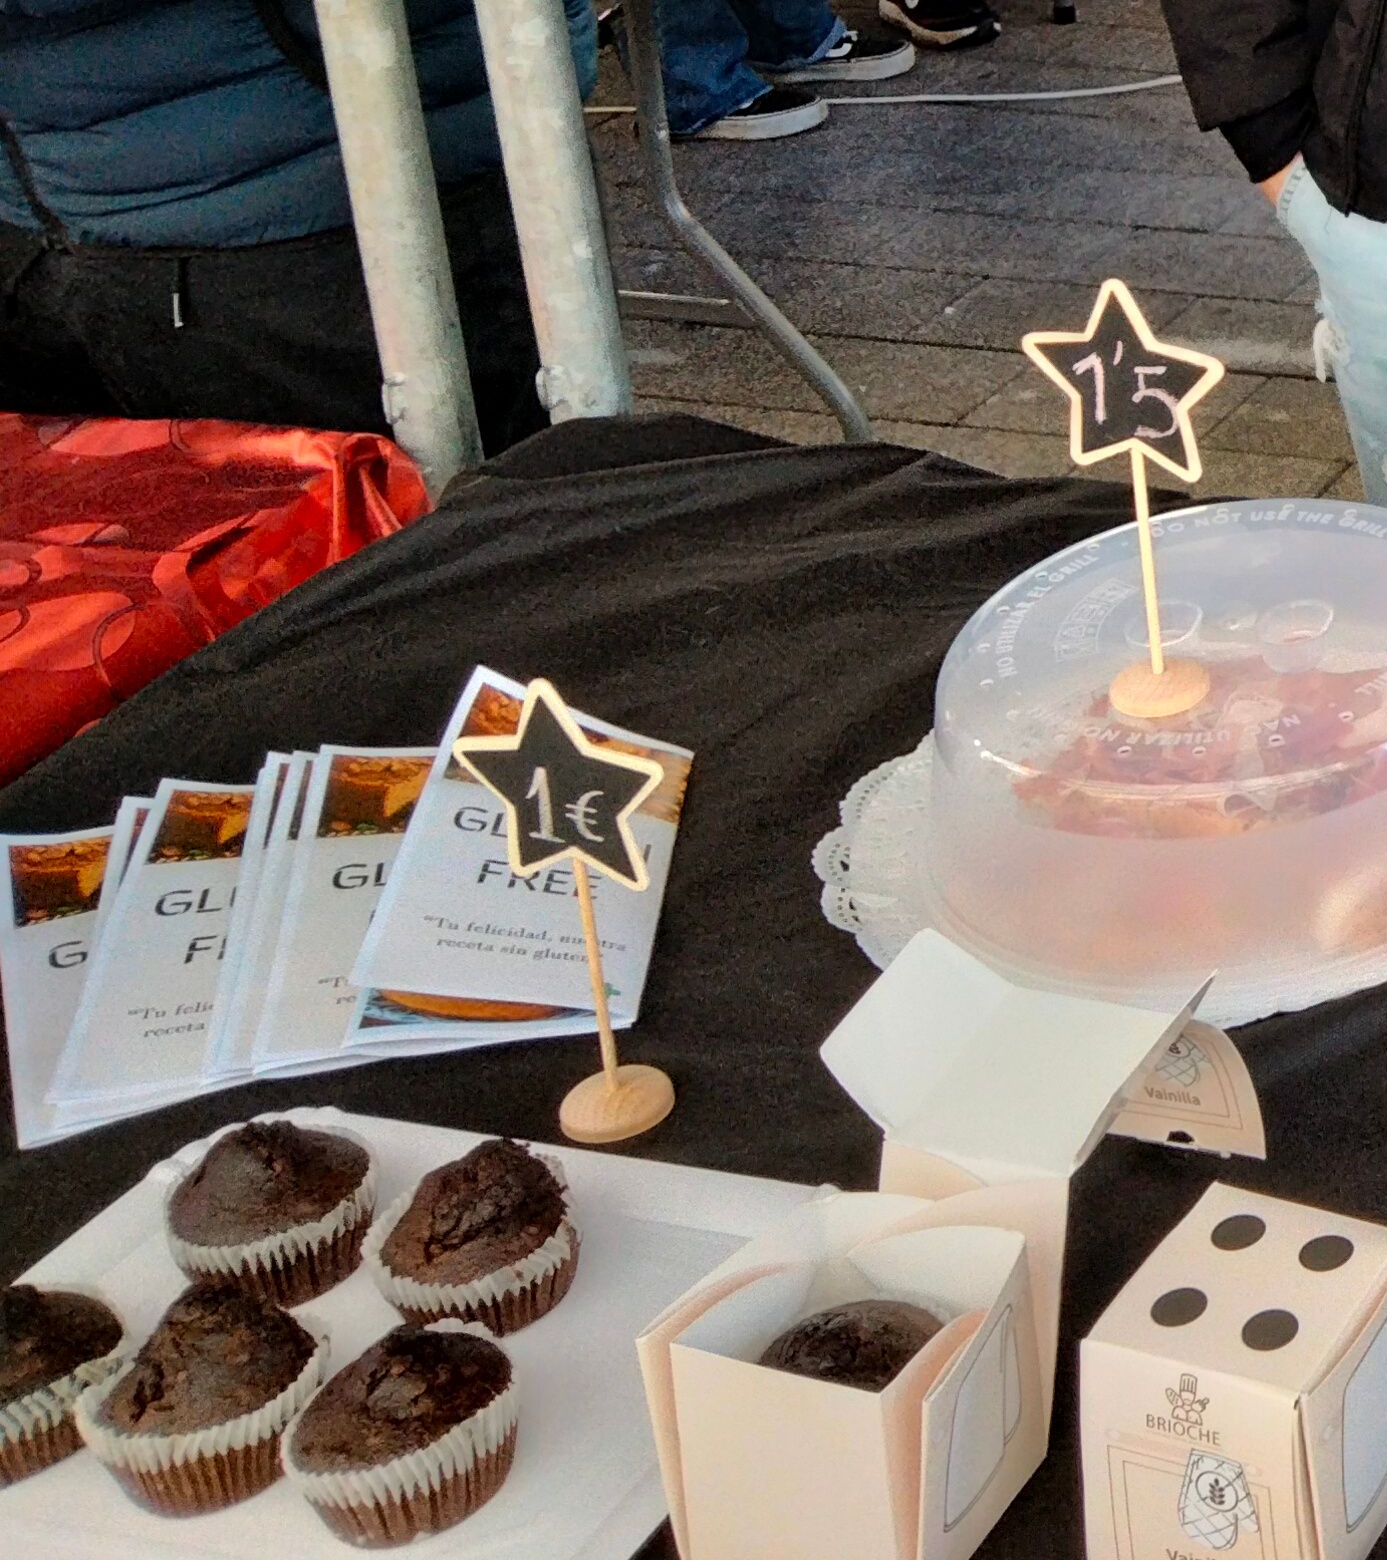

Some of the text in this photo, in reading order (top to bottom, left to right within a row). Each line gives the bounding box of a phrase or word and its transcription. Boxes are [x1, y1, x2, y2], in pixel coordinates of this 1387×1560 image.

[1194, 510, 1242, 528] NOT
[1250, 507, 1288, 522] USE
[1295, 510, 1334, 525] THE
[1047, 553, 1100, 584] GRILL
[436, 937, 495, 953] receta
[499, 945, 528, 956] sin
[558, 933, 627, 953] nutra
[143, 1021, 206, 1039] receta
[1143, 1085, 1202, 1106] Vainilla
[1145, 1412, 1222, 1447] BRIOCHE
